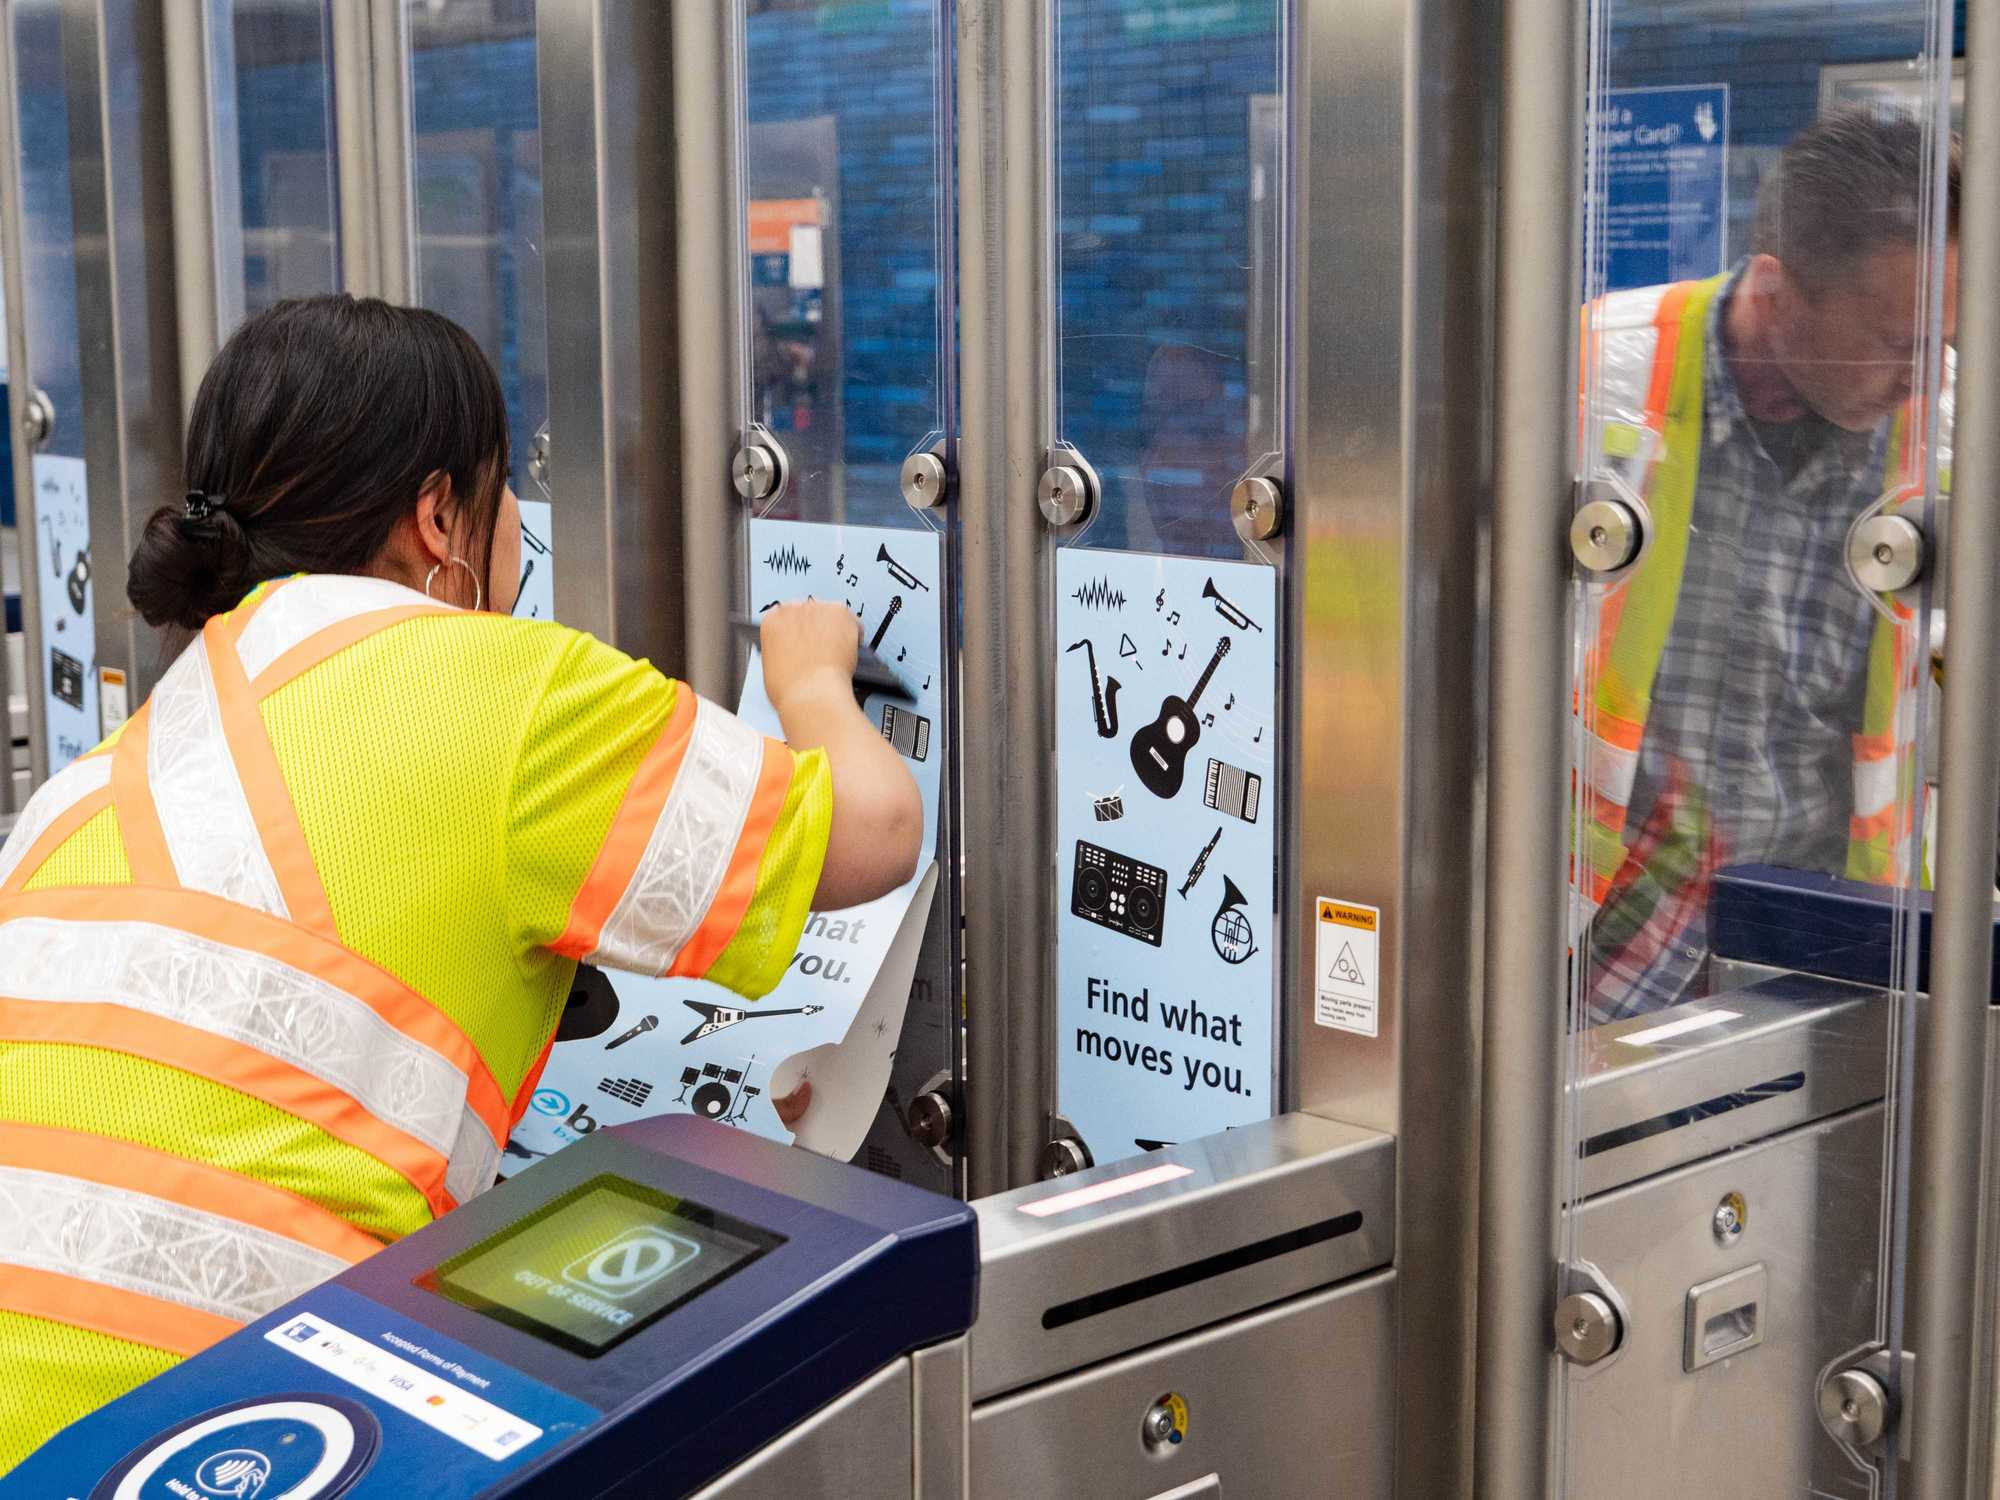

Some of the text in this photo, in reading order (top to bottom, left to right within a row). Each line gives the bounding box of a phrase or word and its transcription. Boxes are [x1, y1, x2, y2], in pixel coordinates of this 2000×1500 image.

[803, 912, 866, 944] hat
[1335, 910, 1373, 925] WARNING
[1087, 976, 1242, 1047] Find what
[1076, 1027, 1252, 1097] moves you.
[515, 1271, 635, 1326] OUT OF SERVICE
[381, 1331, 492, 1390] Accepted Forms of Payment
[388, 1374, 415, 1392] VISA
[165, 1478, 193, 1497] Hold
